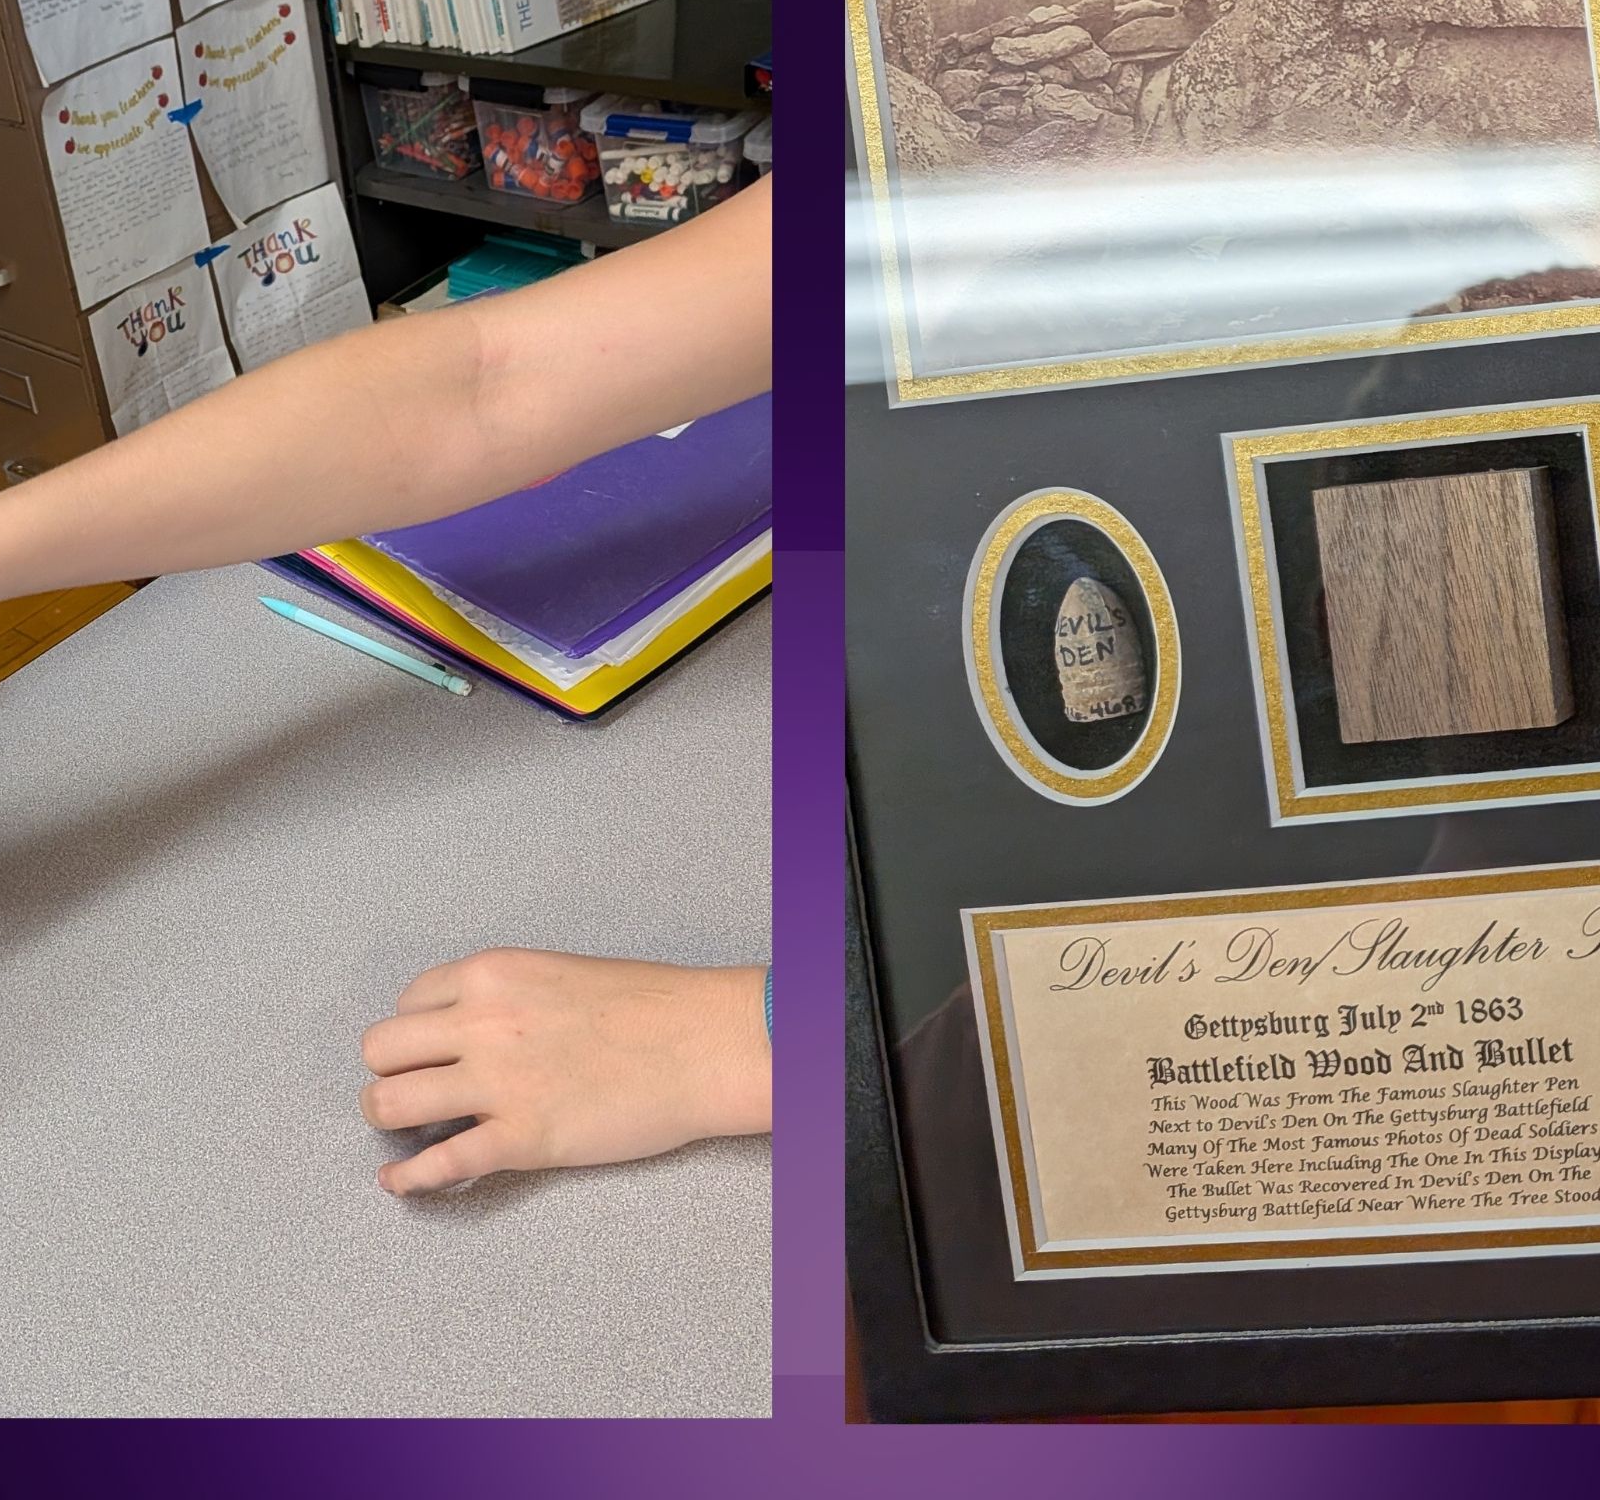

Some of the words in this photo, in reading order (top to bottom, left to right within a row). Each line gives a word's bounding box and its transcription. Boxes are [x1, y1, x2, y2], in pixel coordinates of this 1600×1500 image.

[1049, 936, 1201, 992] Devil's
[1183, 1010, 1331, 1042] Gettysburg
[1337, 1004, 1402, 1037] July
[1410, 1000, 1445, 1028] 2nd
[1455, 995, 1524, 1025] 1863
[1146, 1053, 1296, 1090] Battlefield
[1304, 1048, 1392, 1079] Wood
[1402, 1043, 1464, 1074] And
[1473, 1036, 1574, 1073] Bullet
[1148, 1119, 1192, 1134] Next
[1196, 1119, 1213, 1132] to
[1217, 1113, 1277, 1132] Devil's
[1280, 1114, 1319, 1129] Den
[1322, 1112, 1349, 1128] On
[1351, 1108, 1385, 1126] The
[1389, 1103, 1489, 1127] Gettysburg
[1493, 1094, 1593, 1120] Battlefield
